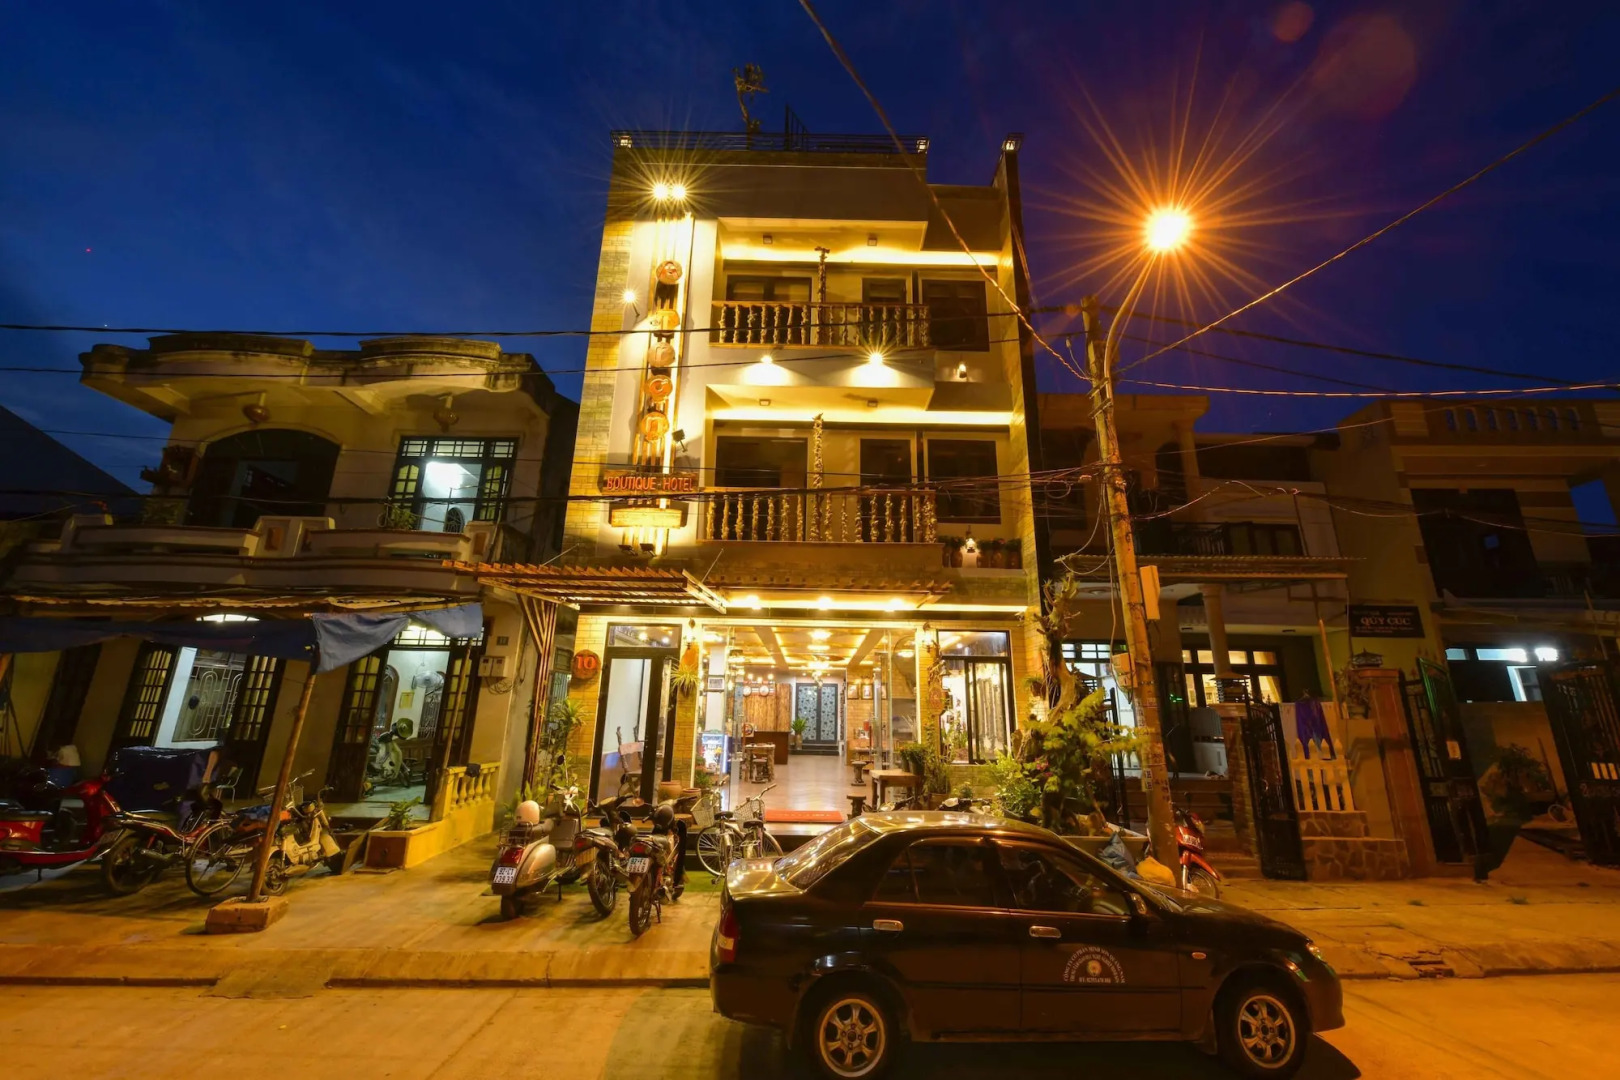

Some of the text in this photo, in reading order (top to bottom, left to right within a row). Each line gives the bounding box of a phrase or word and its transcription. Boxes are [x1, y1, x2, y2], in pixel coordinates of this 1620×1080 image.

[606, 476, 694, 491] BOUTIQUE HOTEL
[576, 655, 597, 670] 10
